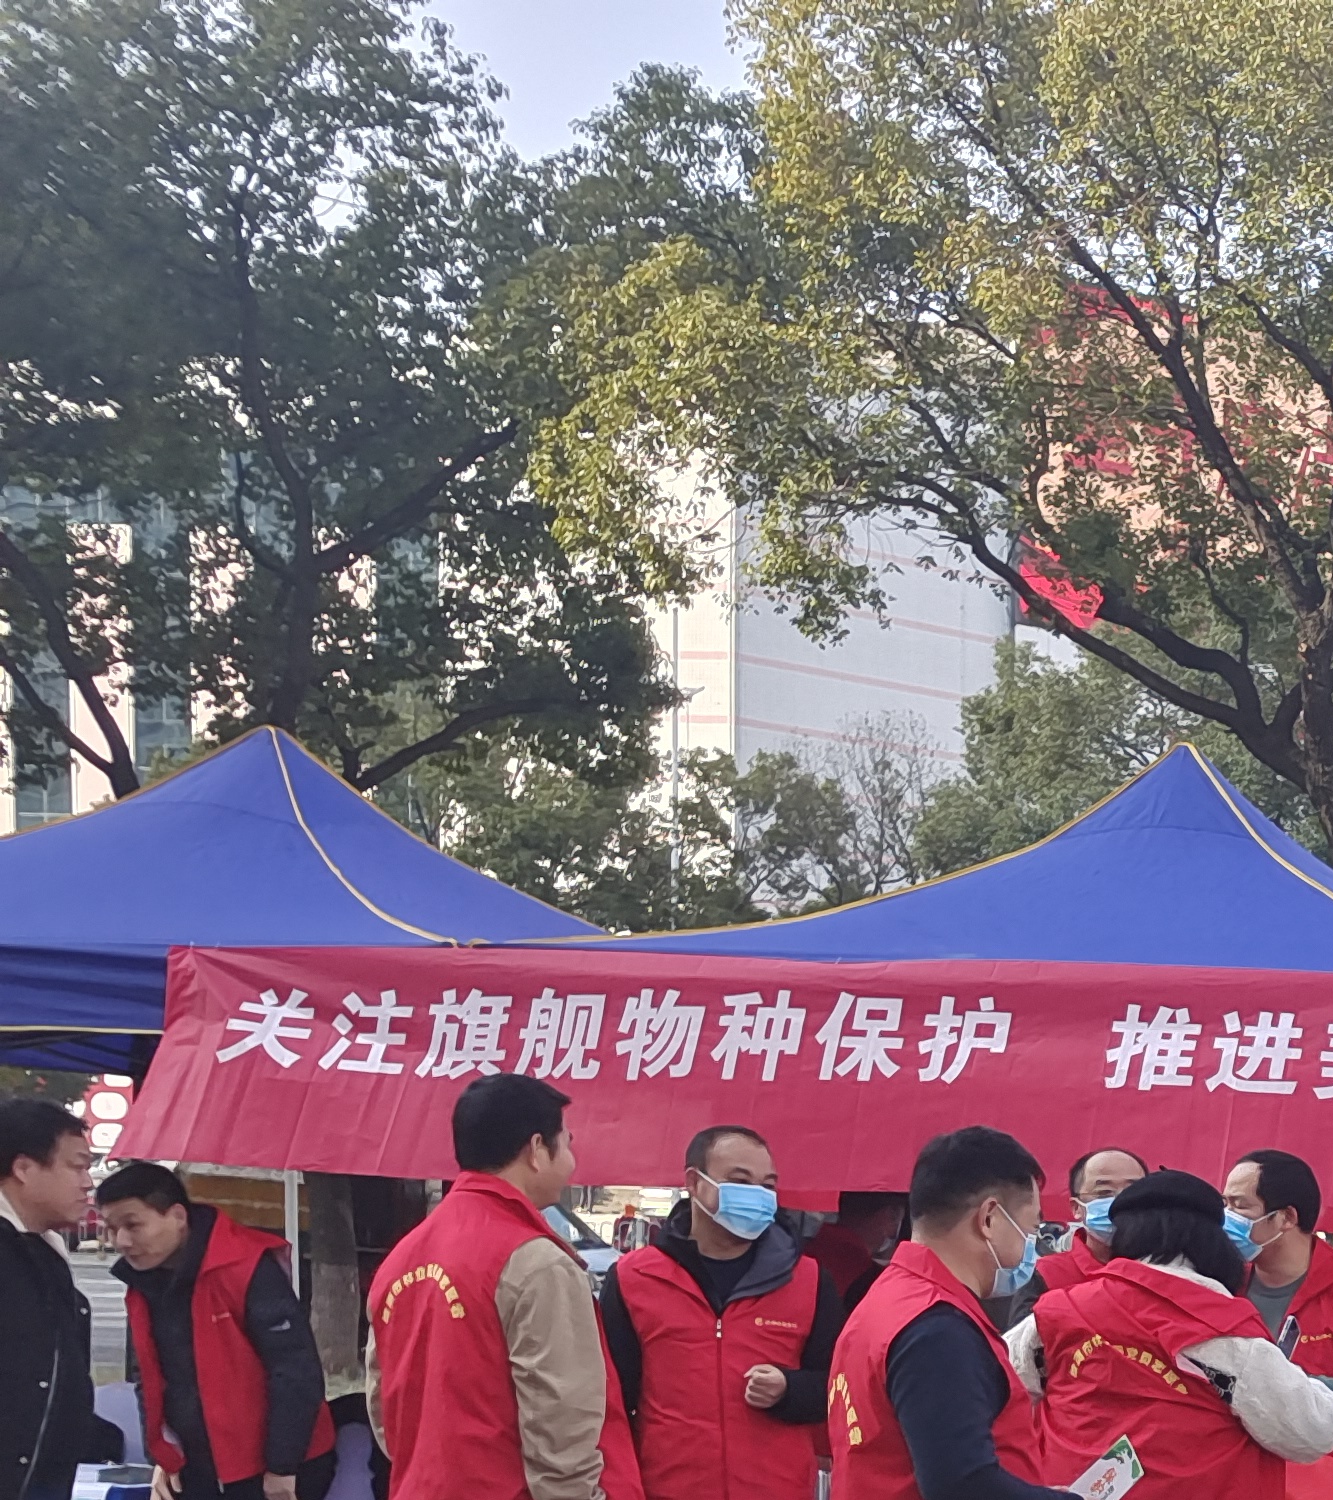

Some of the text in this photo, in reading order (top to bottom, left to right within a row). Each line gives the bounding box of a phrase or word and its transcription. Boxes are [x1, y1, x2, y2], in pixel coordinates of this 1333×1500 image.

[216, 988, 1012, 1084] 关注旗舰物种保护
